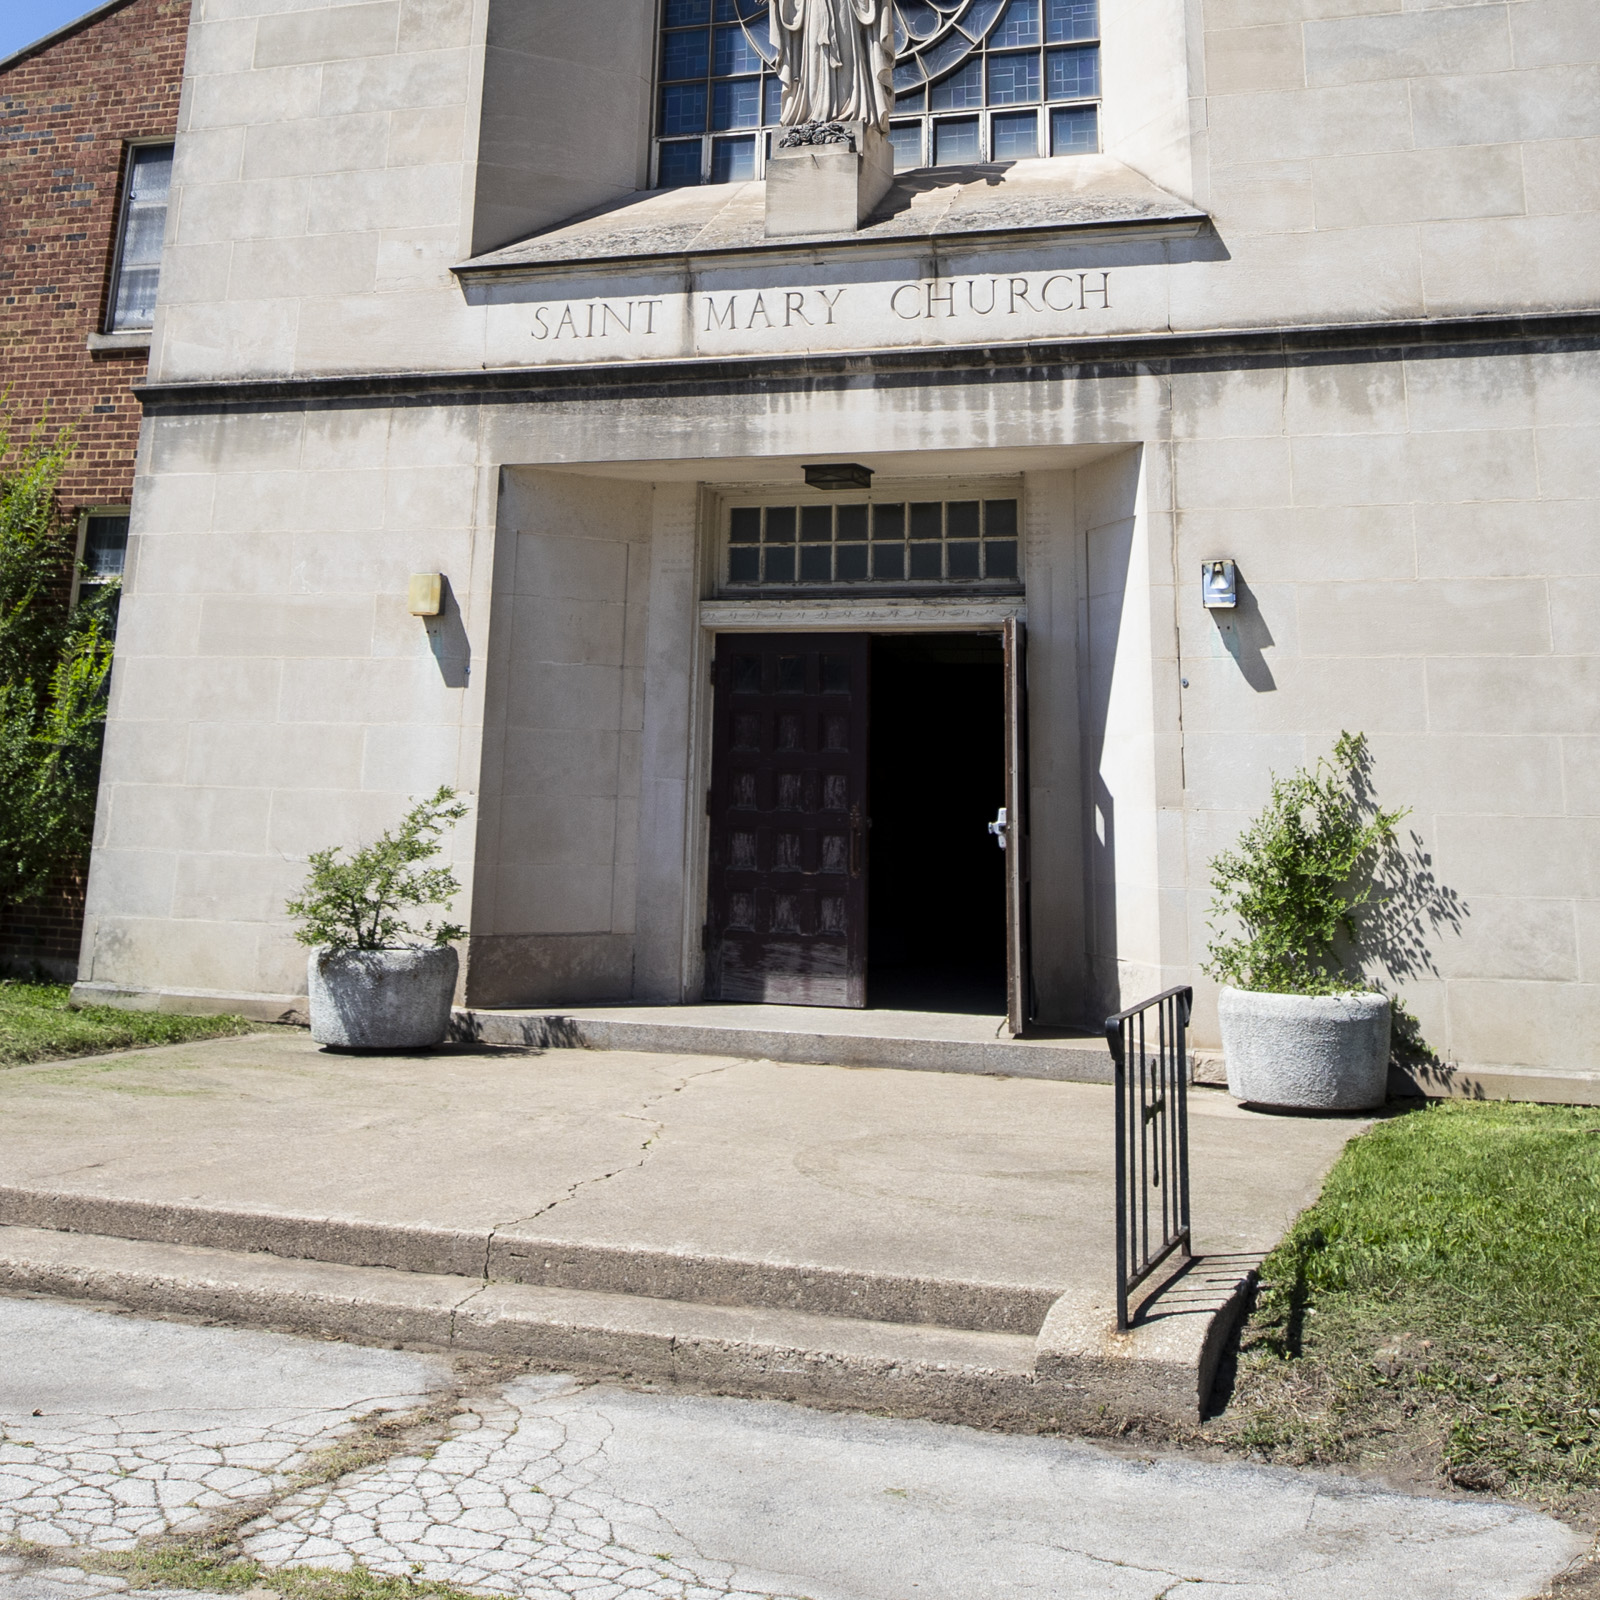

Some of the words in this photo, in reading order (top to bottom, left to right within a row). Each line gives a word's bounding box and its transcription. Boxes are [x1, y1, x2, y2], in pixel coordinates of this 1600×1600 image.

[530, 299, 663, 341] SAINT
[702, 288, 848, 333] MARY
[890, 271, 1114, 321] CHURCH
